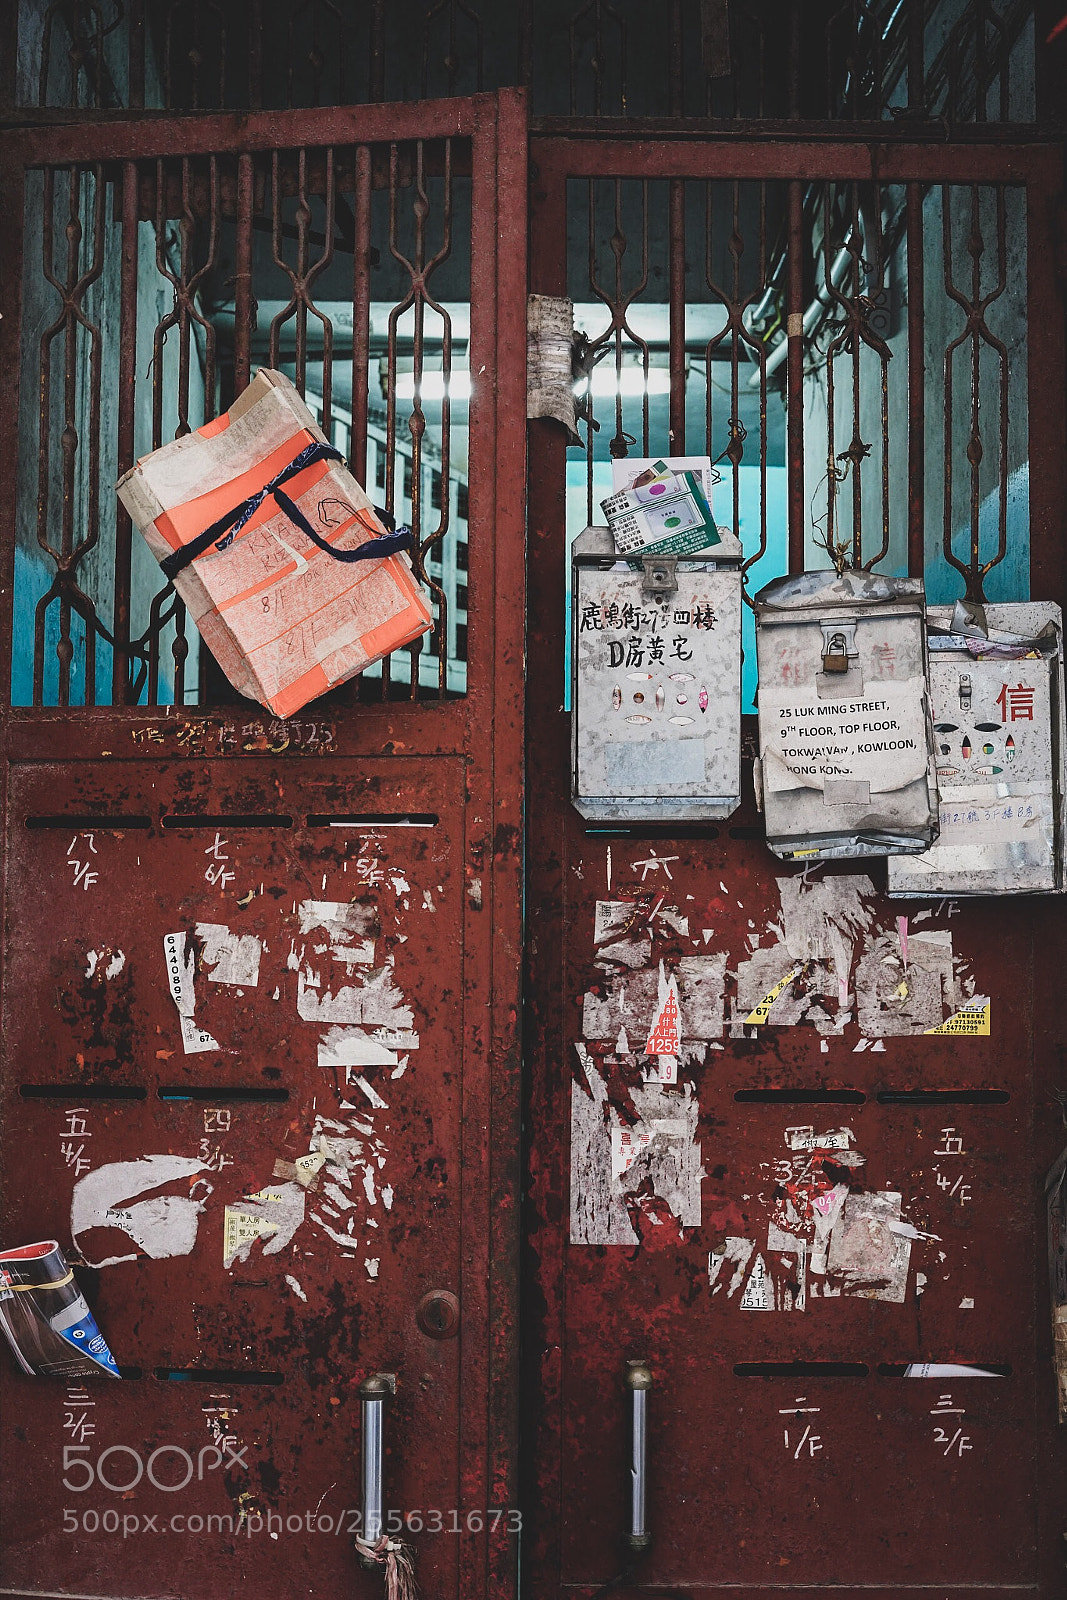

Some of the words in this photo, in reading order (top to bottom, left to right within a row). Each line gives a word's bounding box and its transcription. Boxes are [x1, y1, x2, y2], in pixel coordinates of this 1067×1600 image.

[779, 708, 792, 718] 25
[795, 707, 815, 717] LUK
[817, 704, 847, 715] MING
[849, 701, 890, 713] STREET,
[996, 683, 1035, 722] 信
[799, 726, 837, 737] FLOOR,
[839, 724, 860, 735] TOP
[863, 720, 900, 732] FLOOR,
[857, 739, 917, 754] KOWLOON,
[205, 832, 229, 860] 七
[67, 860, 99, 890] 7/F
[204, 864, 236, 889] 6/F
[59, 1107, 92, 1137] 五
[933, 1127, 966, 1155] 五
[60, 1141, 91, 1177] 4/F
[936, 1172, 972, 1207] 4/F
[63, 1387, 96, 1406] 三
[930, 1394, 966, 1414] 三
[63, 1412, 96, 1443] 2/F
[784, 1424, 823, 1459] 1/F
[933, 1427, 973, 1457] 2/F
